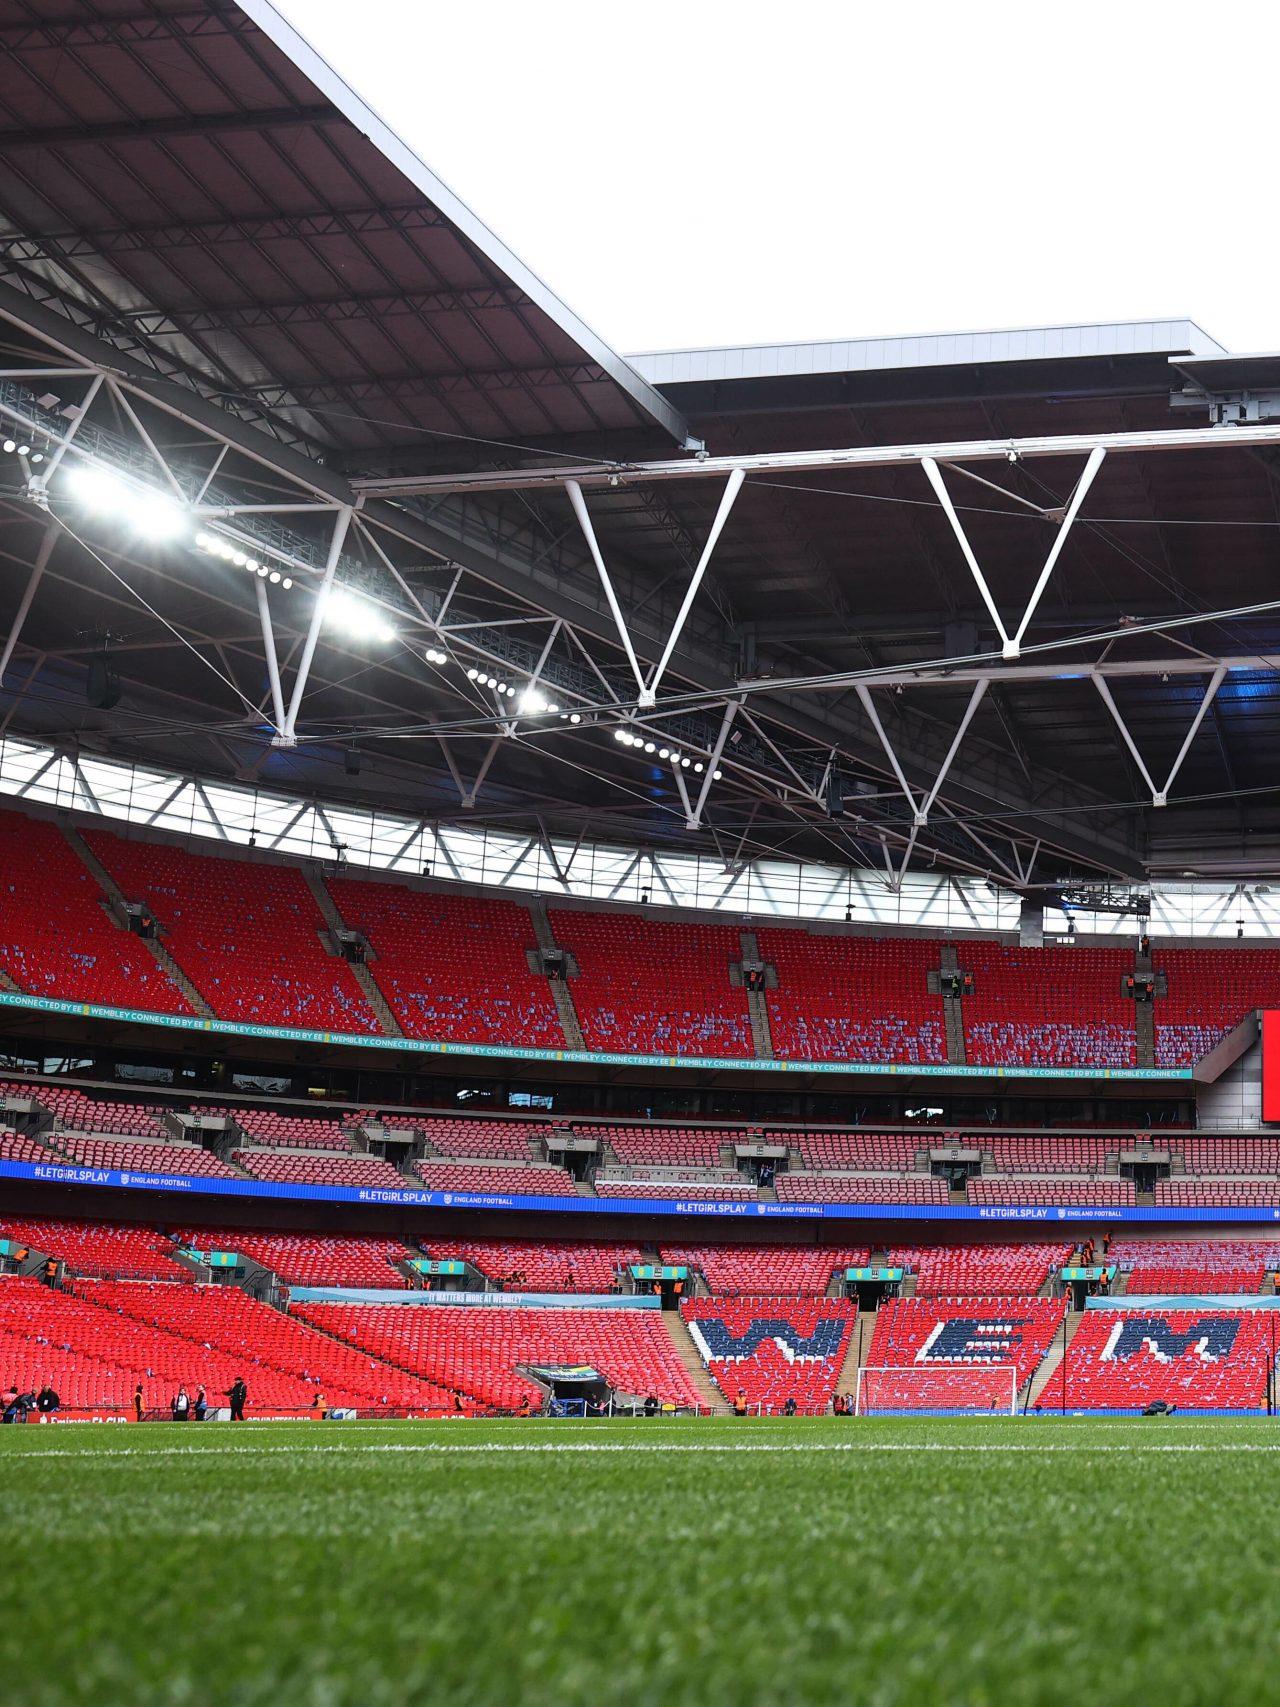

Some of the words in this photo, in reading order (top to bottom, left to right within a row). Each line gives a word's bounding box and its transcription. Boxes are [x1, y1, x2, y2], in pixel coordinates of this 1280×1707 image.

[10, 995, 60, 1009] CONNECTED
[91, 1007, 130, 1018] WEMBLEY
[131, 1012, 181, 1025] CONNECTED
[212, 1022, 250, 1033] WEMBLEY
[251, 1026, 301, 1038] CONNECTED
[331, 1035, 368, 1045] WEMBLEY
[370, 1038, 420, 1049] CONNECTED
[448, 1045, 485, 1054] WEMBLEY
[486, 1047, 534, 1057] CONNECTED
[564, 1053, 600, 1061] WEMBLEY
[601, 1055, 649, 1064] CONNECTED
[677, 1059, 713, 1067] WEMBLEY
[713, 1060, 760, 1069] CONNECTED
[788, 1063, 824, 1071] WEMBLEY
[824, 1064, 870, 1072] CONNECTED
[897, 1066, 932, 1074] WEMBLEY
[932, 1067, 978, 1075] CONNECTED
[131, 1176, 160, 1185] ENGLAND
[160, 1179, 191, 1187] FOOTBALL
[465, 1293, 484, 1302] MORE
[494, 1294, 522, 1303] WEMBLEY
